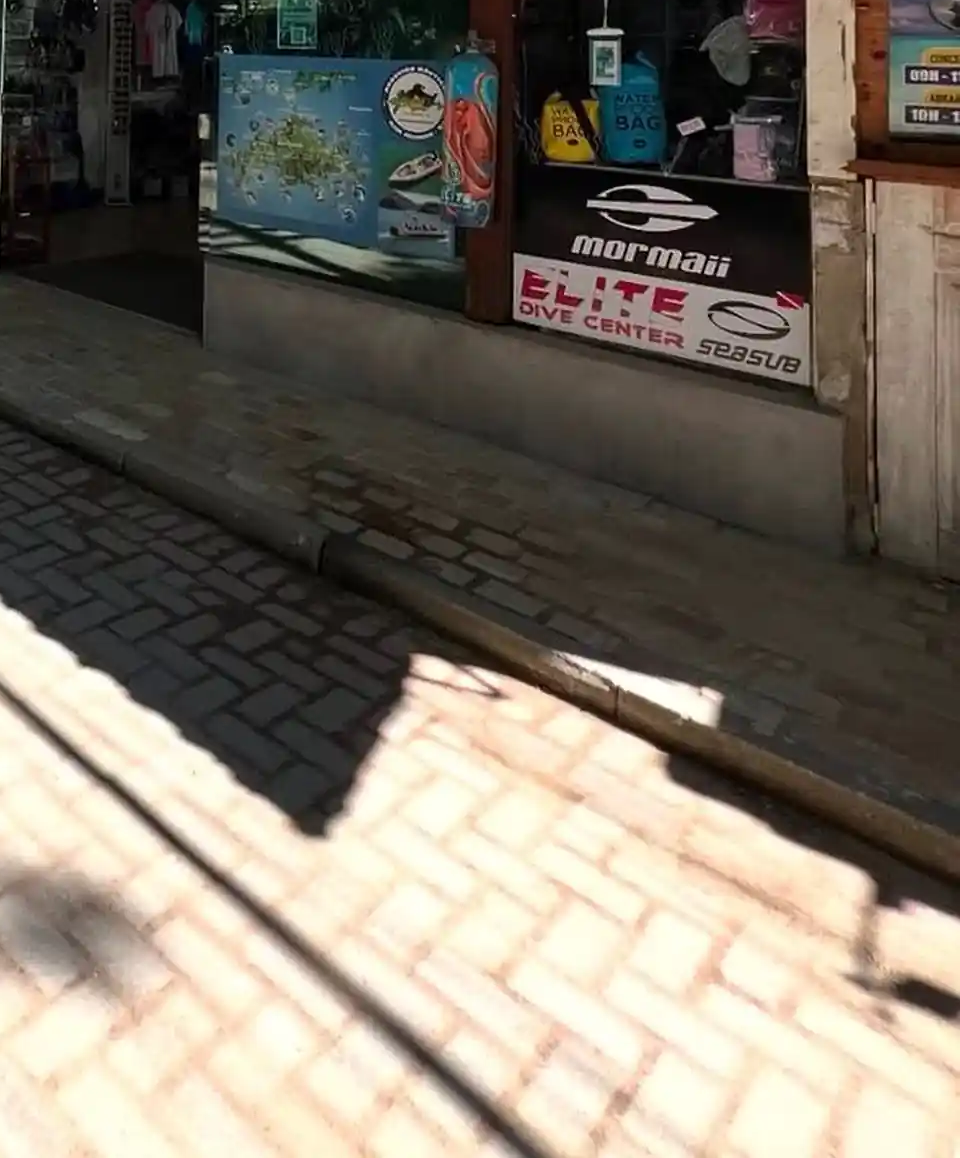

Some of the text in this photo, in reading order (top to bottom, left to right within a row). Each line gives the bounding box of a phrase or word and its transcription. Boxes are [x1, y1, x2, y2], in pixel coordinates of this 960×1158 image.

[616, 115, 662, 132] BAG
[571, 234, 733, 279] mormaii
[520, 267, 690, 323] ELITE
[518, 299, 685, 350] DIVE CENTER
